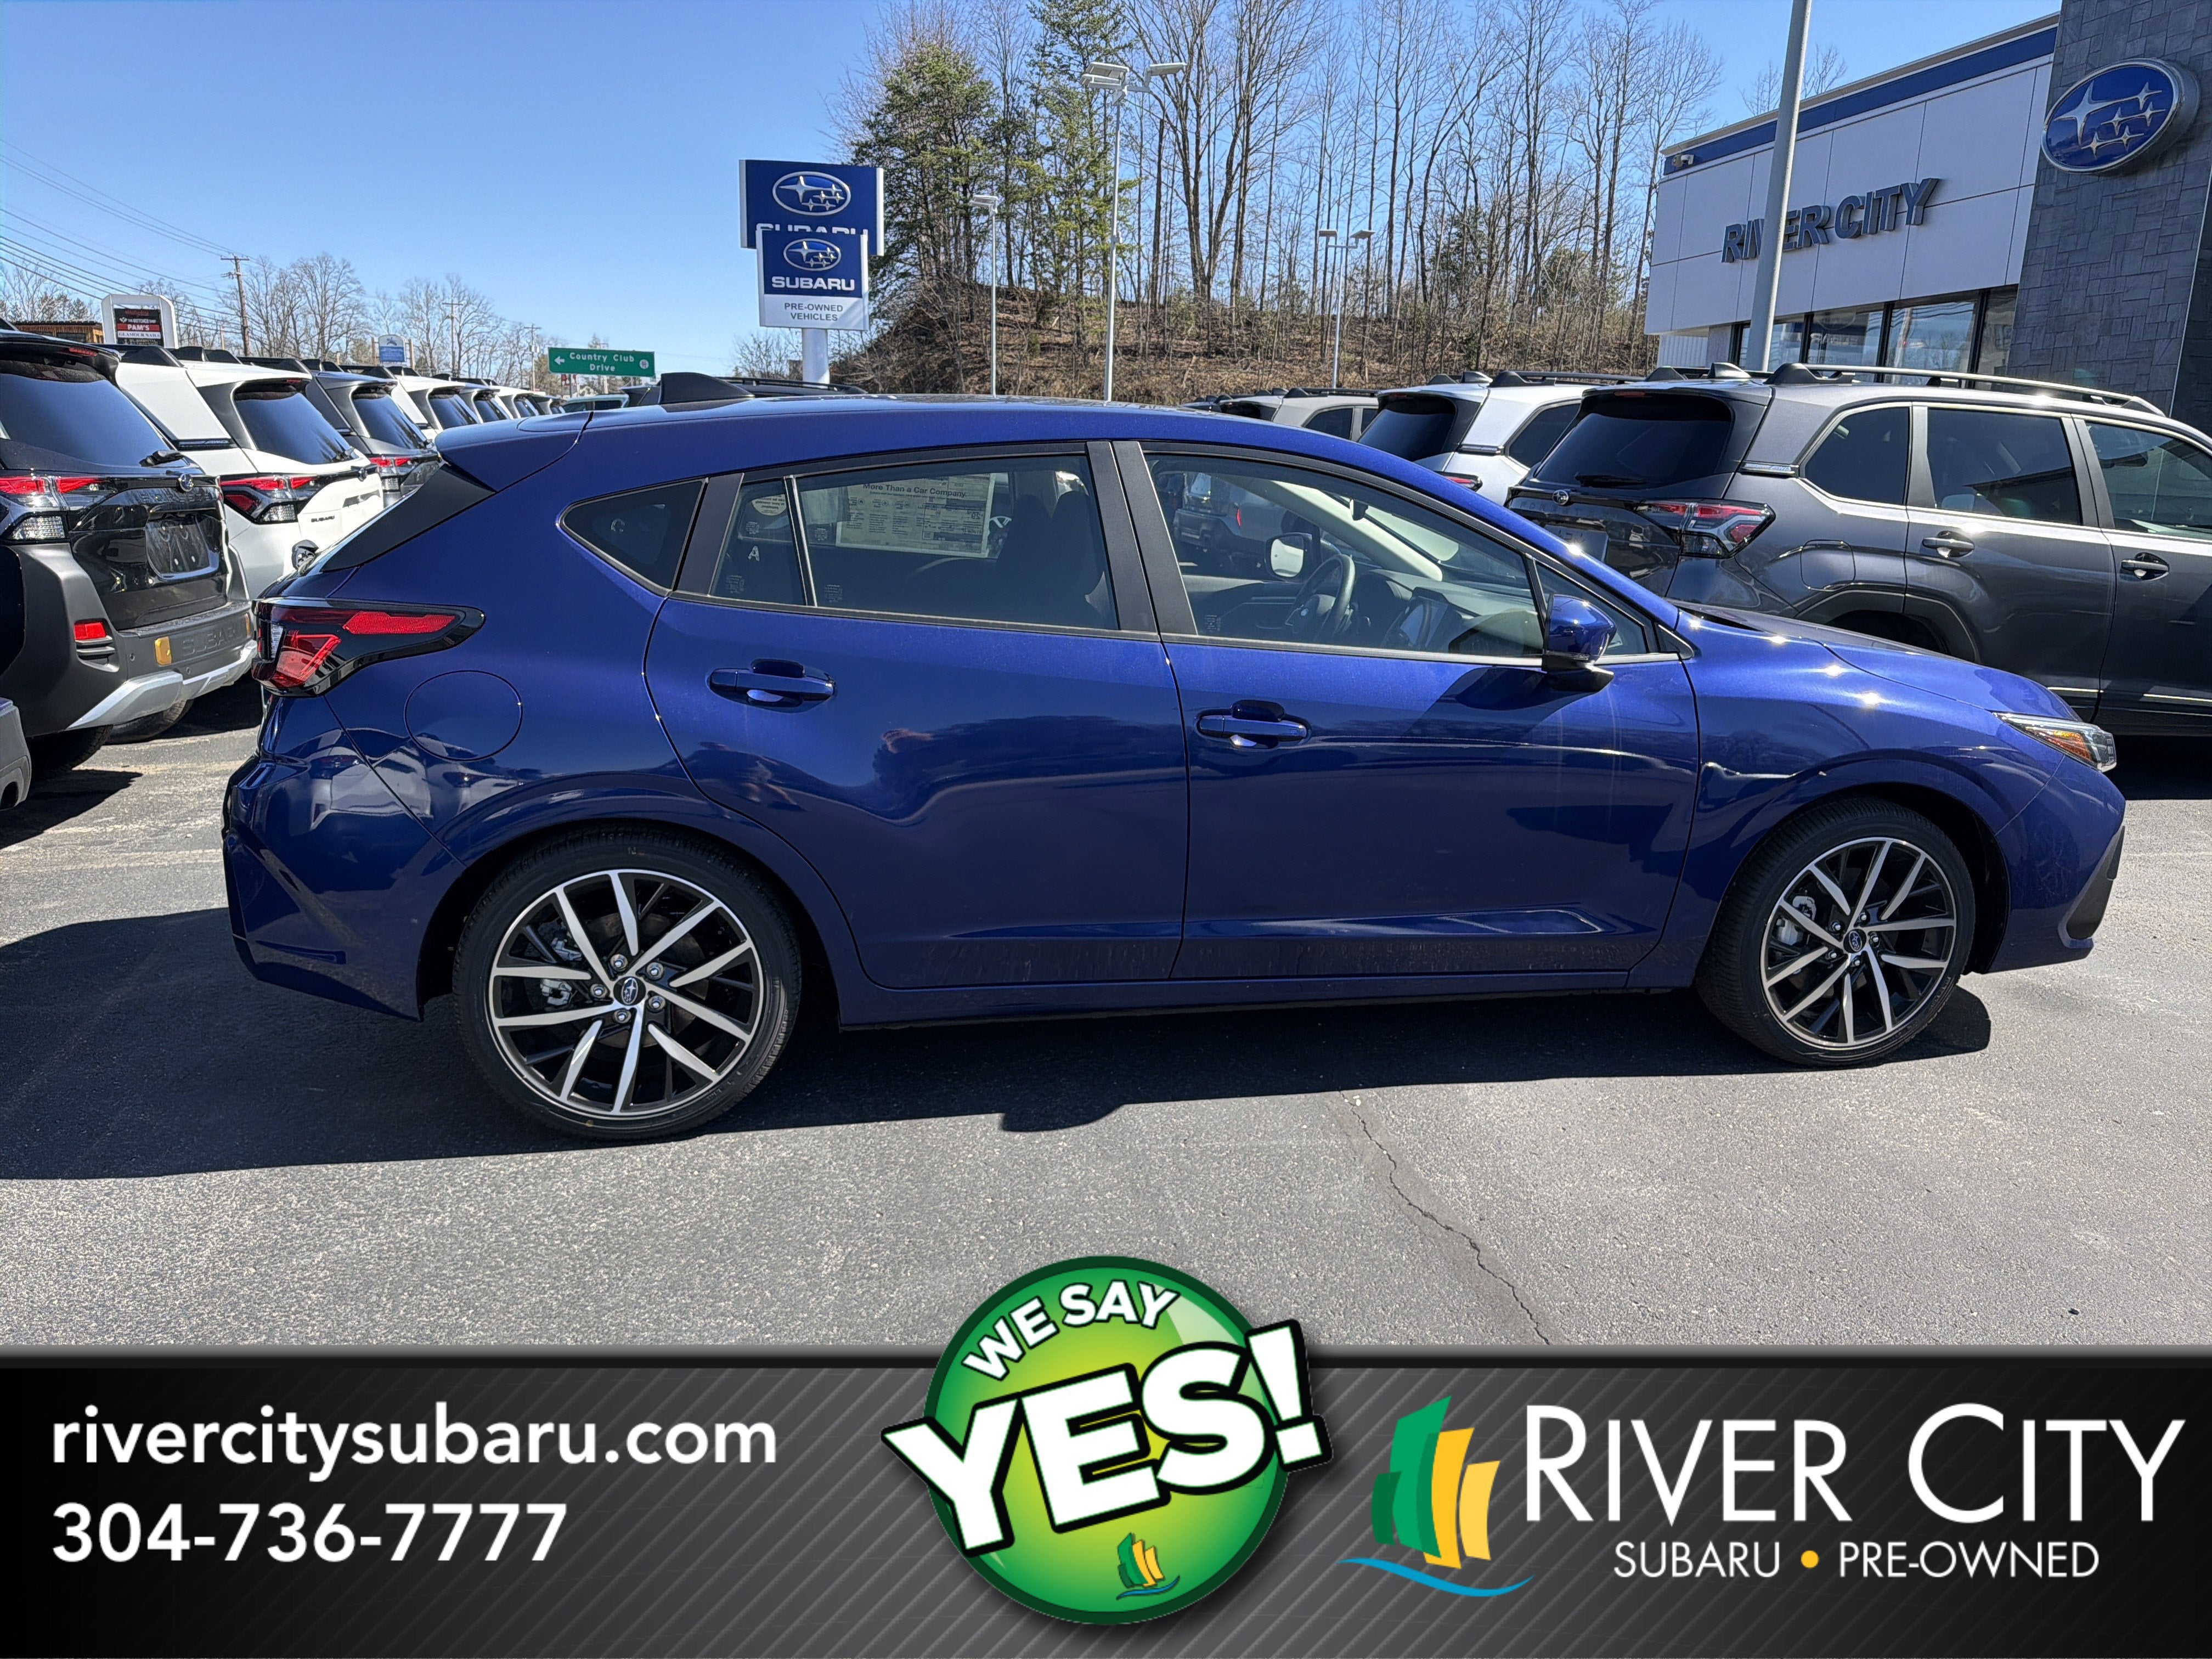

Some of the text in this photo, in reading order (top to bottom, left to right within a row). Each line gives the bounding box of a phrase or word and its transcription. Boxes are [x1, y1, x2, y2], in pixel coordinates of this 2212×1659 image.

[1835, 178, 1939, 239] CITY
[771, 276, 855, 291] SUBARU
[784, 302, 843, 312] PRE-OWNED
[791, 313, 838, 321] VEHICLES
[569, 352, 635, 362] Country Club
[589, 363, 616, 371] Drive
